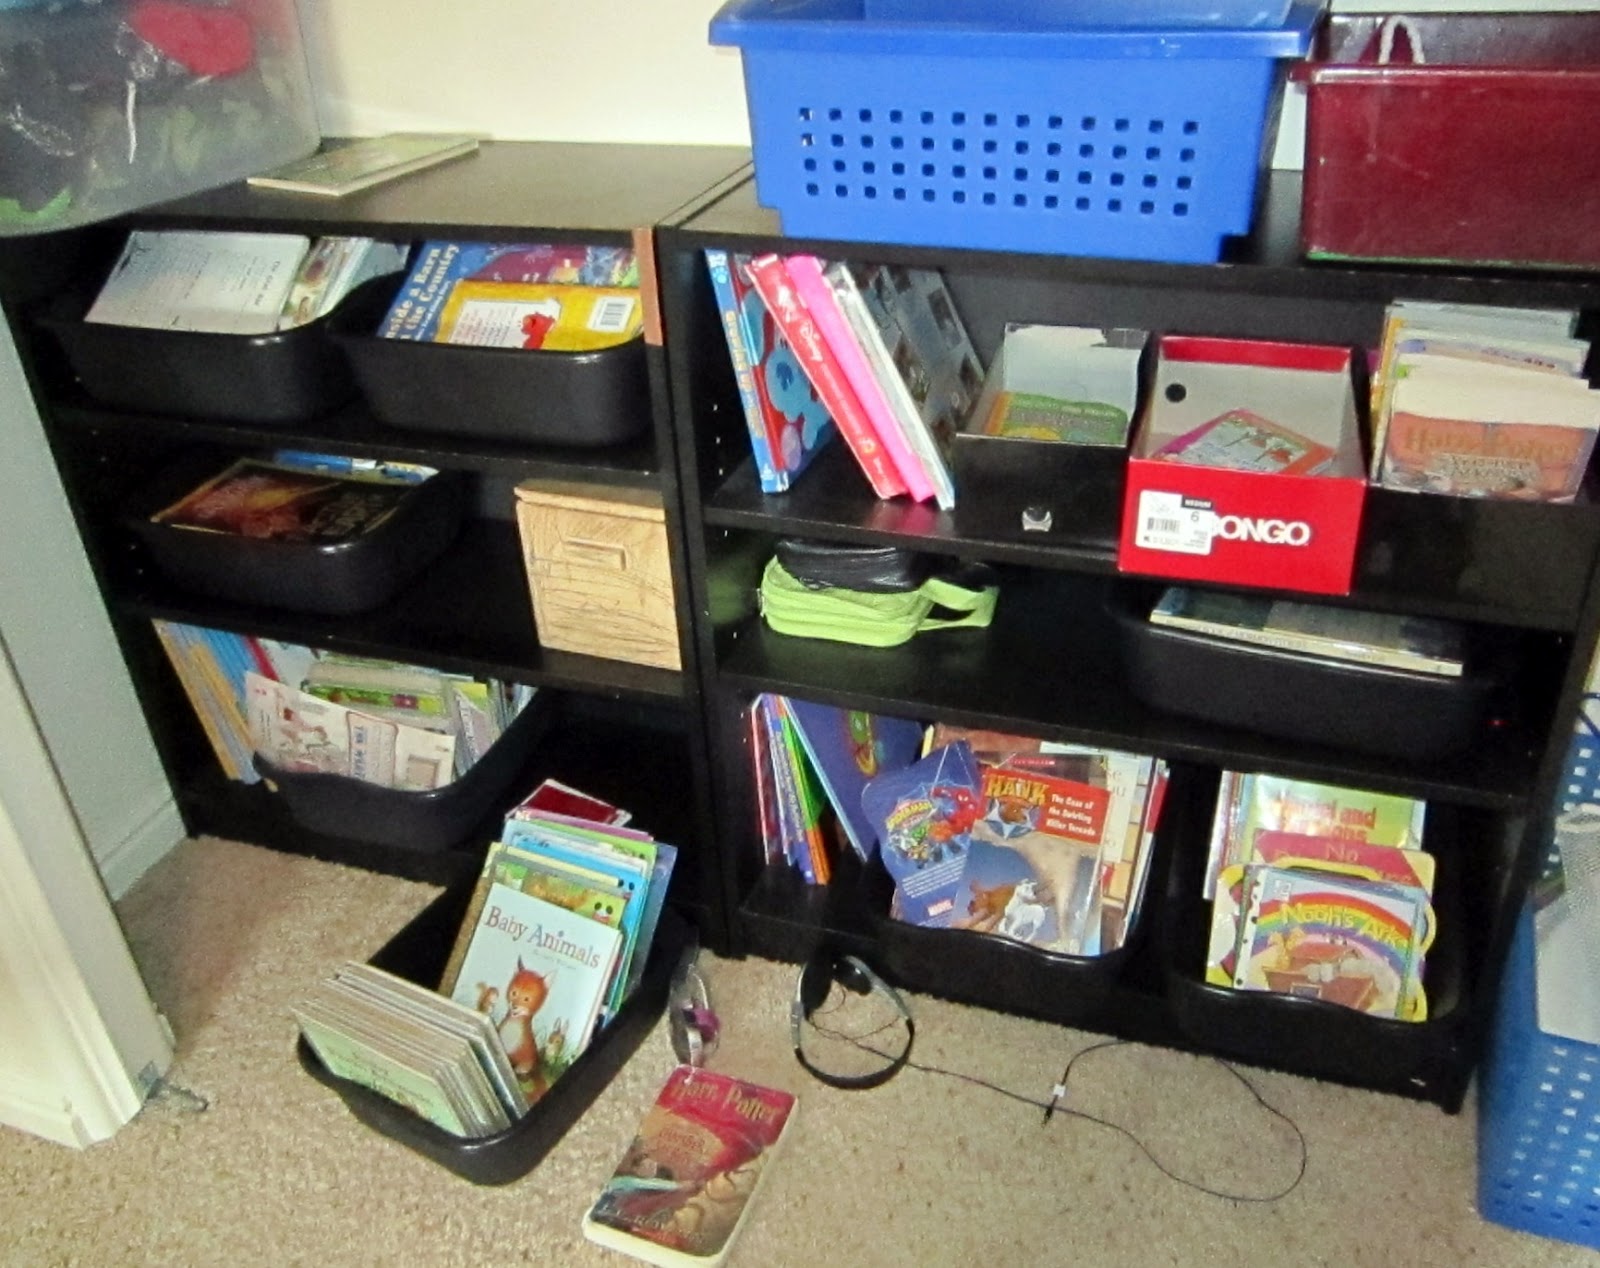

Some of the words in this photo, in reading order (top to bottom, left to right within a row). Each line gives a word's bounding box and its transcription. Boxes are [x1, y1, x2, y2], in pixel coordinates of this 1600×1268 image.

[418, 243, 460, 303] Country
[384, 299, 414, 339] nside
[413, 248, 441, 284] Barn
[1190, 510, 1200, 523] 6
[984, 773, 1051, 806] HANK
[1051, 793, 1065, 804] The
[1066, 795, 1083, 809] Case
[1084, 800, 1095, 810] of
[1046, 818, 1067, 831] Killer
[1067, 822, 1097, 837] Tornado
[1048, 805, 1061, 817] the
[1061, 809, 1092, 825] Swirling
[484, 905, 529, 942] Baby
[527, 923, 601, 969] Animals
[724, 1083, 781, 1122] Potter
